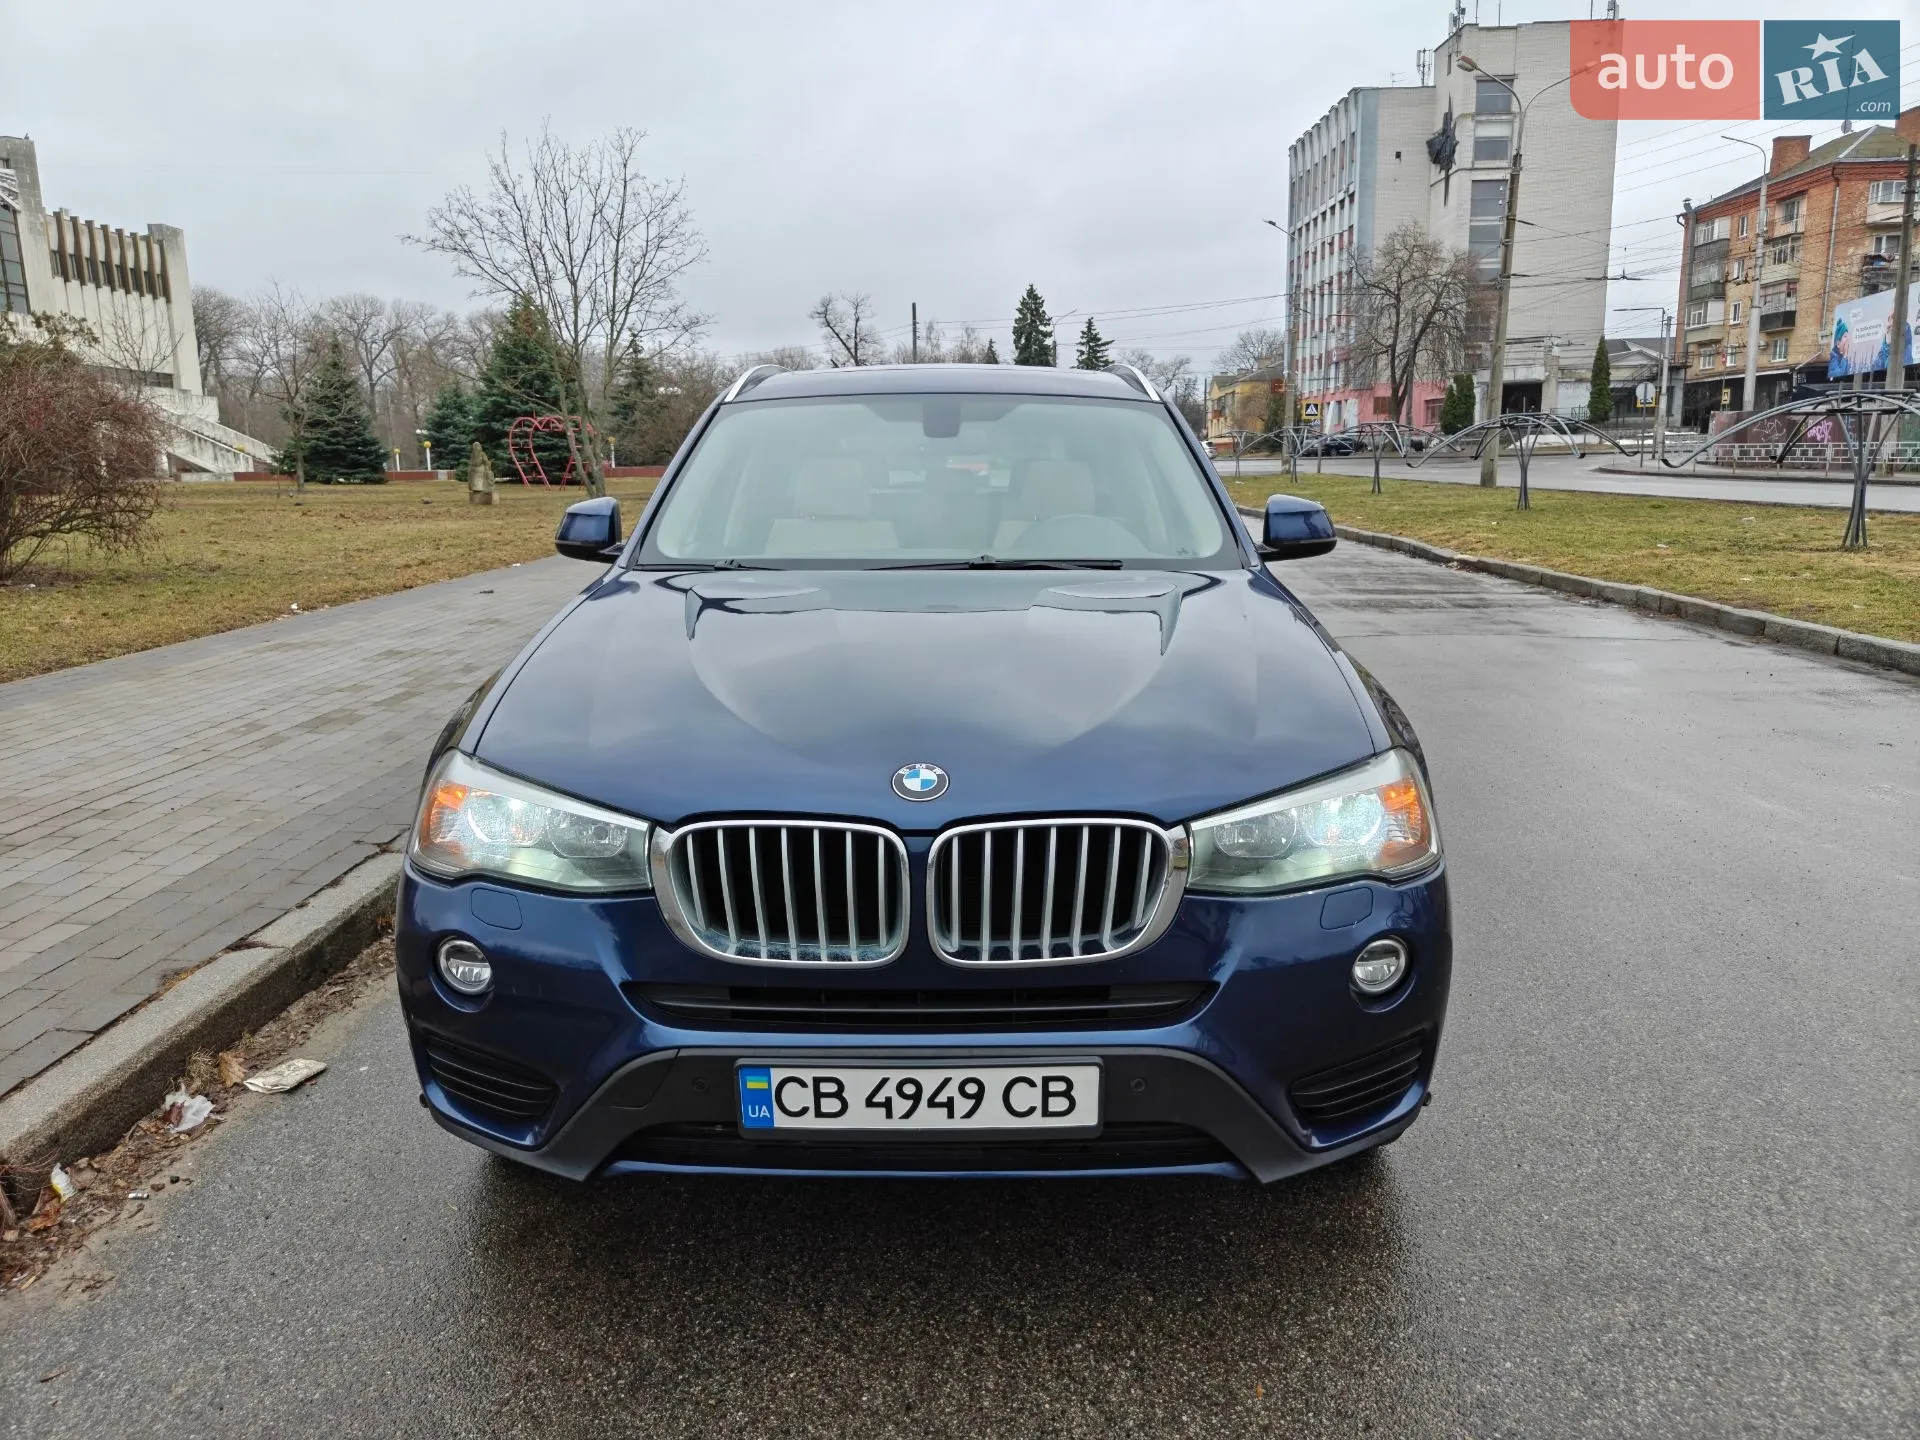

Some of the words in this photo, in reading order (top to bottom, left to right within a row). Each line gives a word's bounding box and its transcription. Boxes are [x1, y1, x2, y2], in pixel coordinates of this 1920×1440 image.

[897, 763, 945, 775] BMW
[774, 1075, 849, 1119] CB
[864, 1076, 986, 1121] 4949
[1002, 1075, 1077, 1119] CB
[748, 1105, 771, 1119] UA
